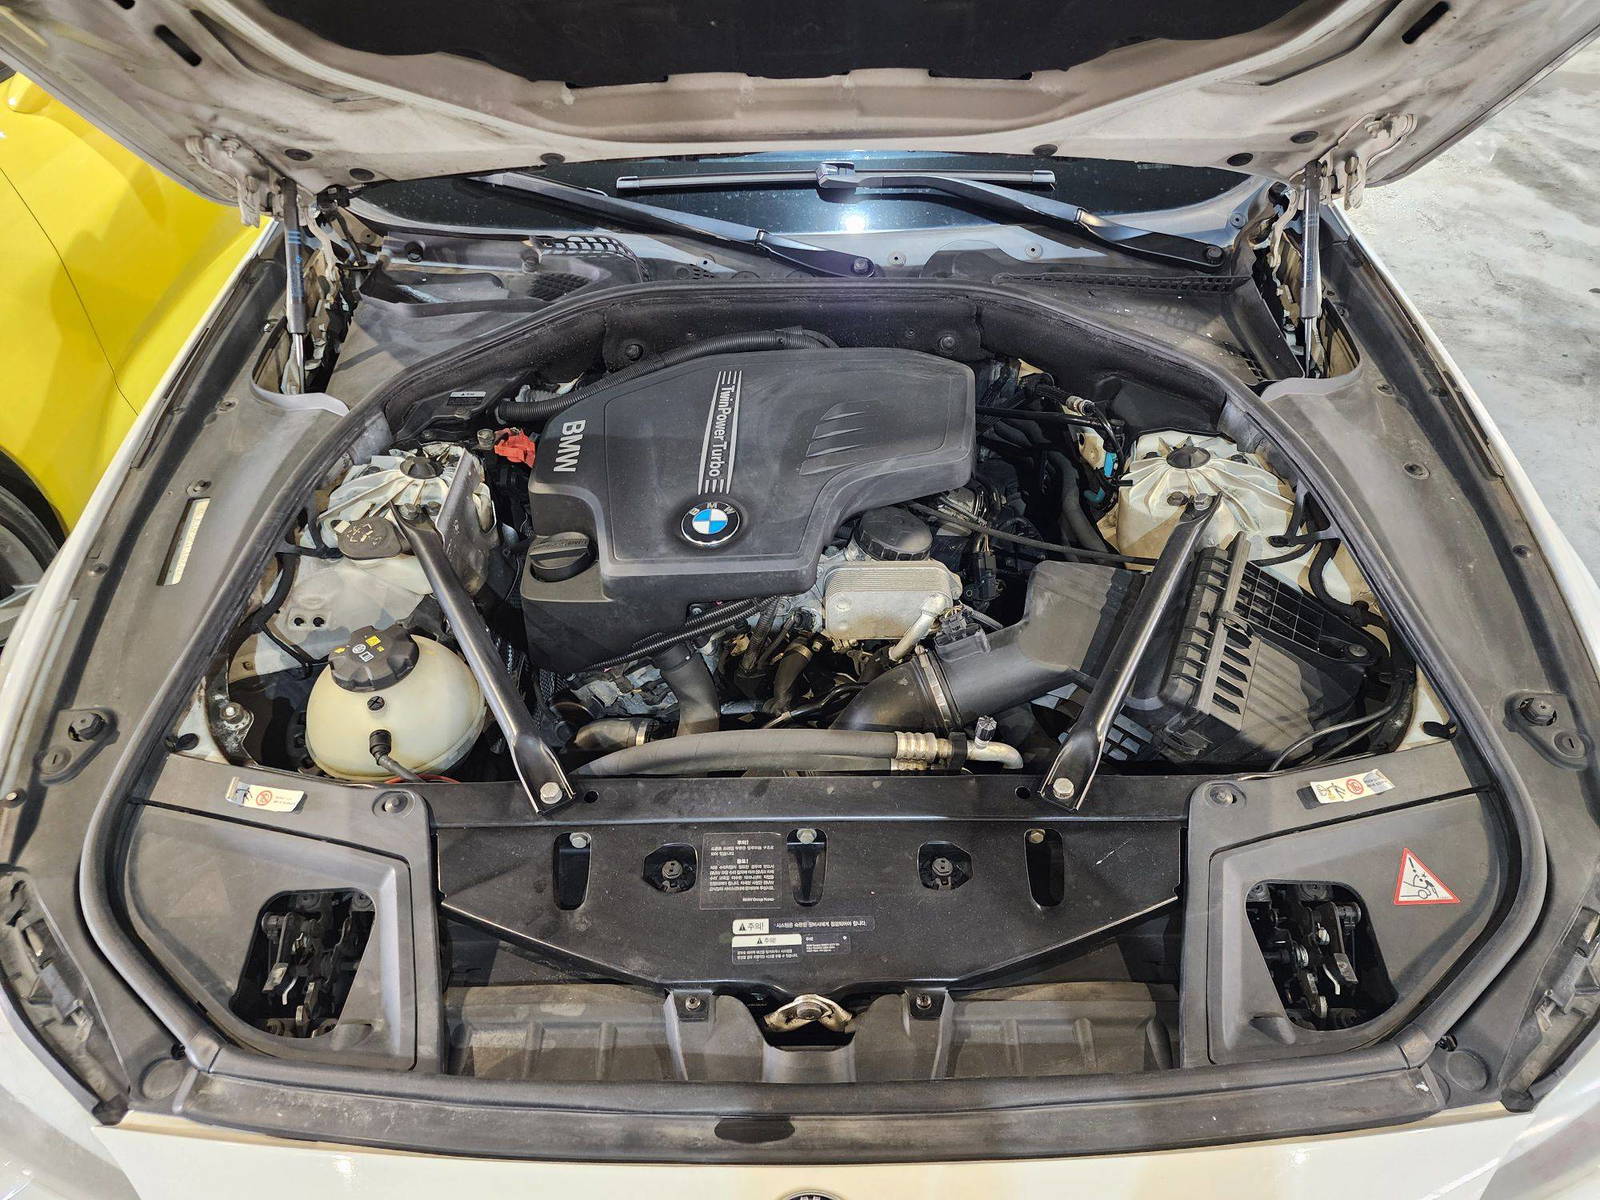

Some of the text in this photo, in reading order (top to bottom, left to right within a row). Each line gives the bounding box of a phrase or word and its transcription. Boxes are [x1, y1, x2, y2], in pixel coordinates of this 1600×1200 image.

[553, 419, 587, 473] BMW
[708, 441, 728, 477] Turbo
[747, 922, 764, 931] 주의!
